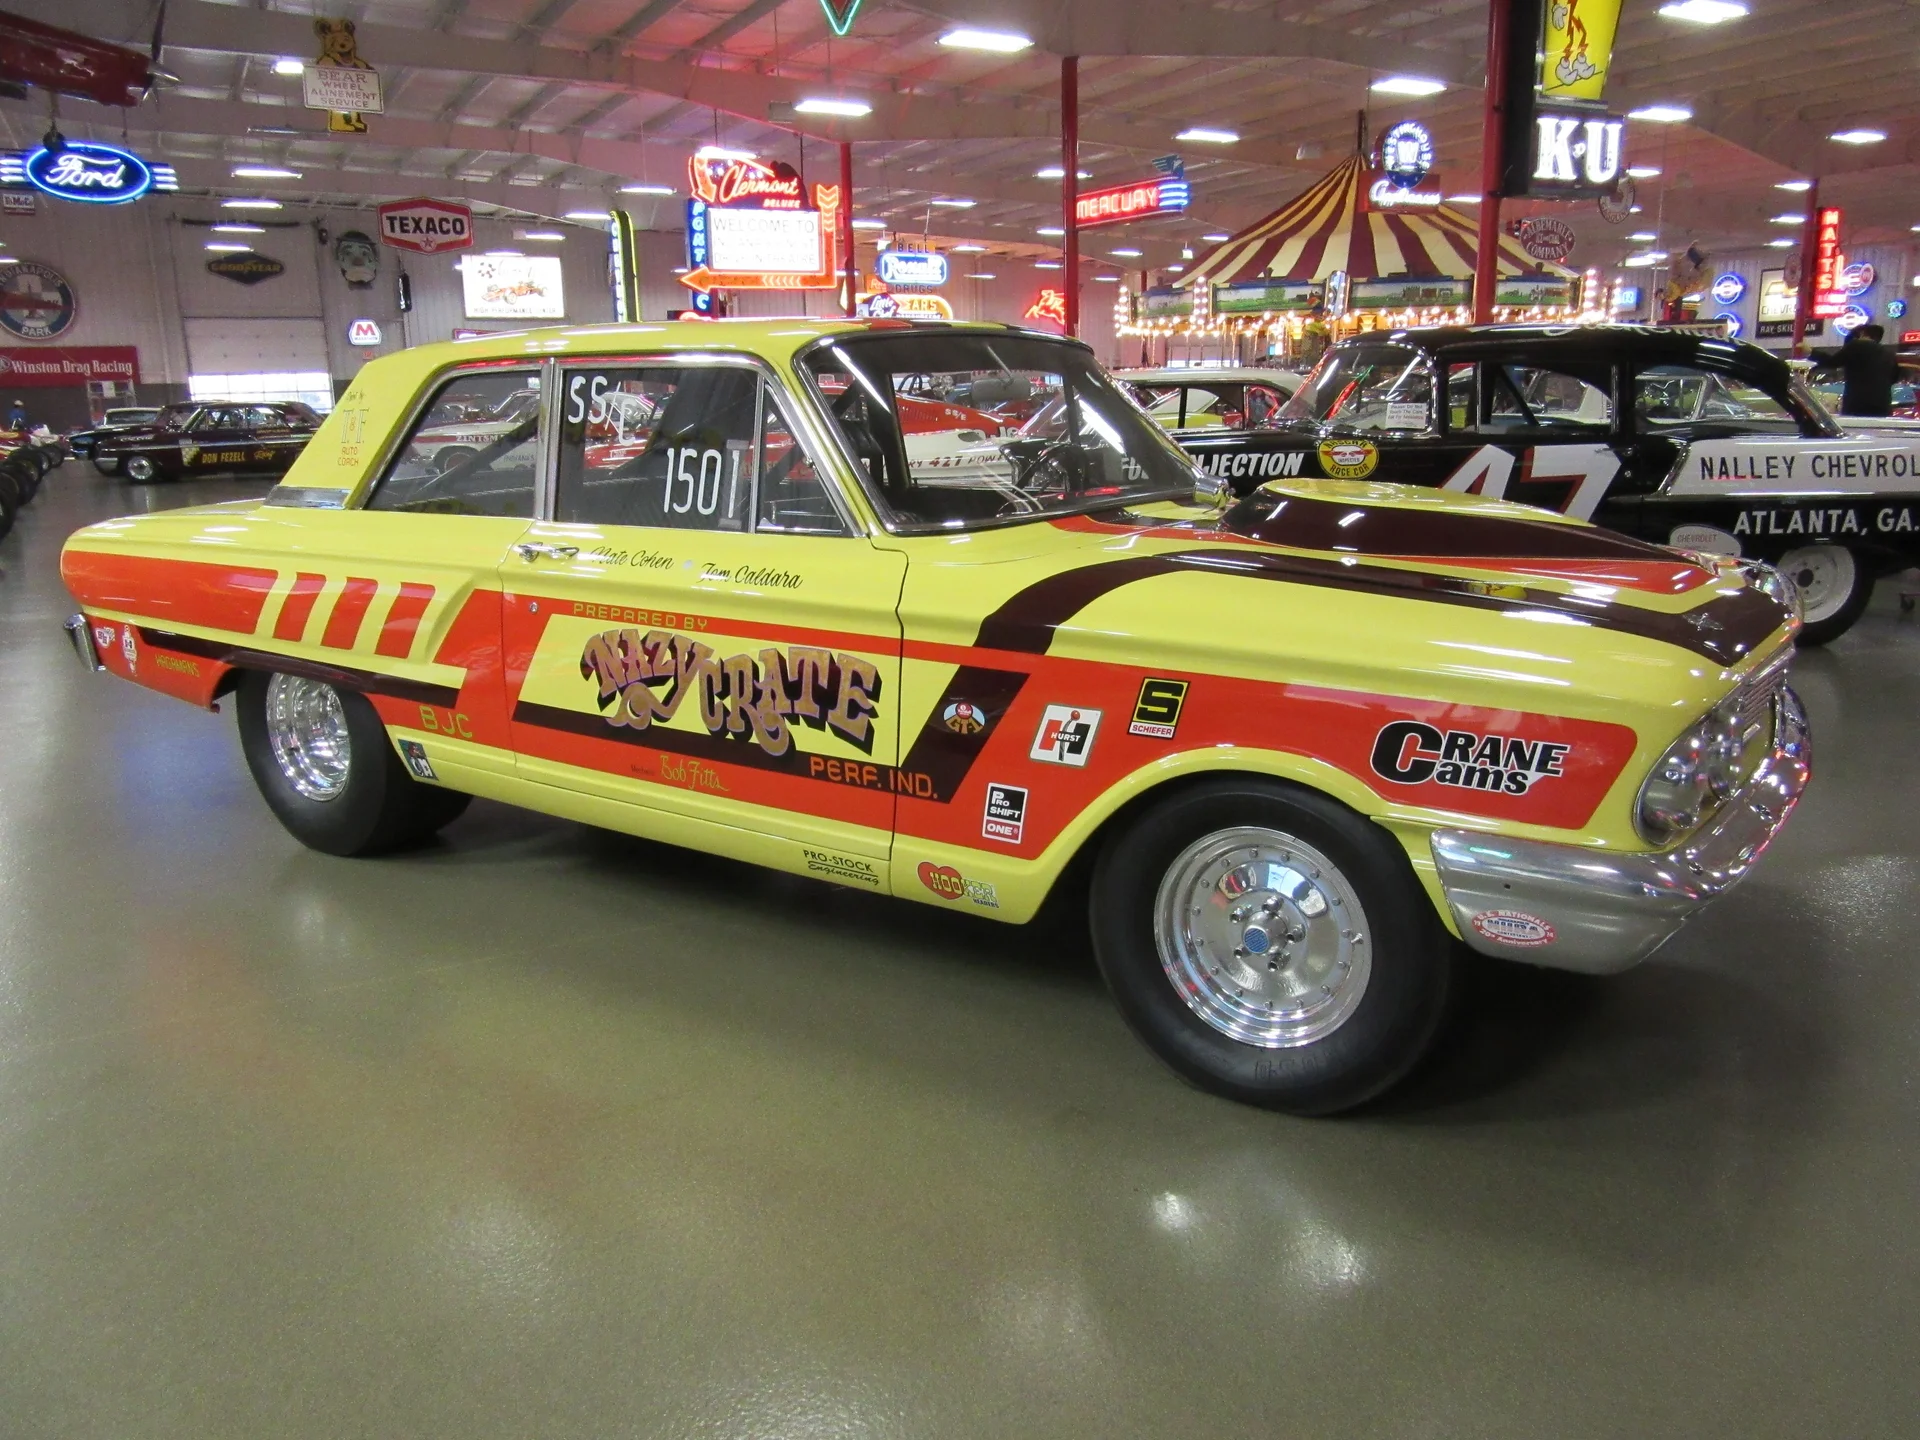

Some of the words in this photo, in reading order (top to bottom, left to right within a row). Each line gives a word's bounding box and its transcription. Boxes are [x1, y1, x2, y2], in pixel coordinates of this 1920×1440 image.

[318, 70, 367, 83] BEAR
[322, 81, 364, 91] WHEEL
[310, 88, 377, 100] ALINEMENT
[321, 98, 369, 108] SERVICE
[45, 154, 125, 188] Ford
[719, 164, 799, 203] Clermont
[763, 199, 800, 208] DELUXE
[1076, 187, 1158, 219] MERCURY
[386, 215, 465, 236] TEXACO
[713, 217, 789, 233] WELCOME
[796, 220, 815, 234] TO
[692, 201, 710, 310] PONTC
[897, 243, 930, 253] BELL
[1526, 241, 1570, 260] COMPANY
[0, 265, 63, 287] NDIANAPOLIS
[895, 284, 934, 294] DRUGS
[21, 326, 53, 338] PARK
[1776, 322, 1816, 333] SKILAN
[12, 361, 61, 374] Winston
[62, 360, 91, 376] Drag
[93, 360, 133, 376] Racing
[456, 432, 502, 442] ZINTSM
[202, 453, 218, 464] DON
[220, 451, 246, 463] FEZELL
[342, 446, 358, 455] AUTO
[337, 457, 359, 467] COACH
[929, 456, 963, 467] 427
[1191, 452, 1305, 478] NJECTION
[1330, 464, 1351, 477] RACE
[1353, 463, 1369, 476] CAR
[1701, 456, 1796, 480] NALLEY
[1811, 454, 1920, 479] CHEVROL
[663, 447, 740, 518] 1501
[1733, 509, 1868, 536] ATLANTA,
[1877, 508, 1920, 532] GA.
[1676, 534, 1718, 543] CHEVROLET
[630, 550, 675, 570] Cohen
[734, 565, 804, 590] Caldara
[573, 603, 677, 627] PREPARED
[683, 619, 708, 630] BY
[1136, 680, 1185, 724] S
[419, 705, 473, 738] BJC
[1132, 724, 1173, 736] SCHIEFER
[1051, 731, 1081, 742] HURST
[1370, 720, 1571, 785] CRANE
[659, 754, 687, 782] Bob
[809, 755, 882, 788] PERF.
[889, 770, 938, 799] IND.
[990, 806, 1021, 818] SHIFT
[803, 850, 874, 873] PRO-STOCK
[808, 862, 881, 886] Engineering
[929, 871, 997, 902] HOOKER
[1498, 910, 1551, 931] NATIONALS
[1496, 936, 1548, 946] Anniversary
